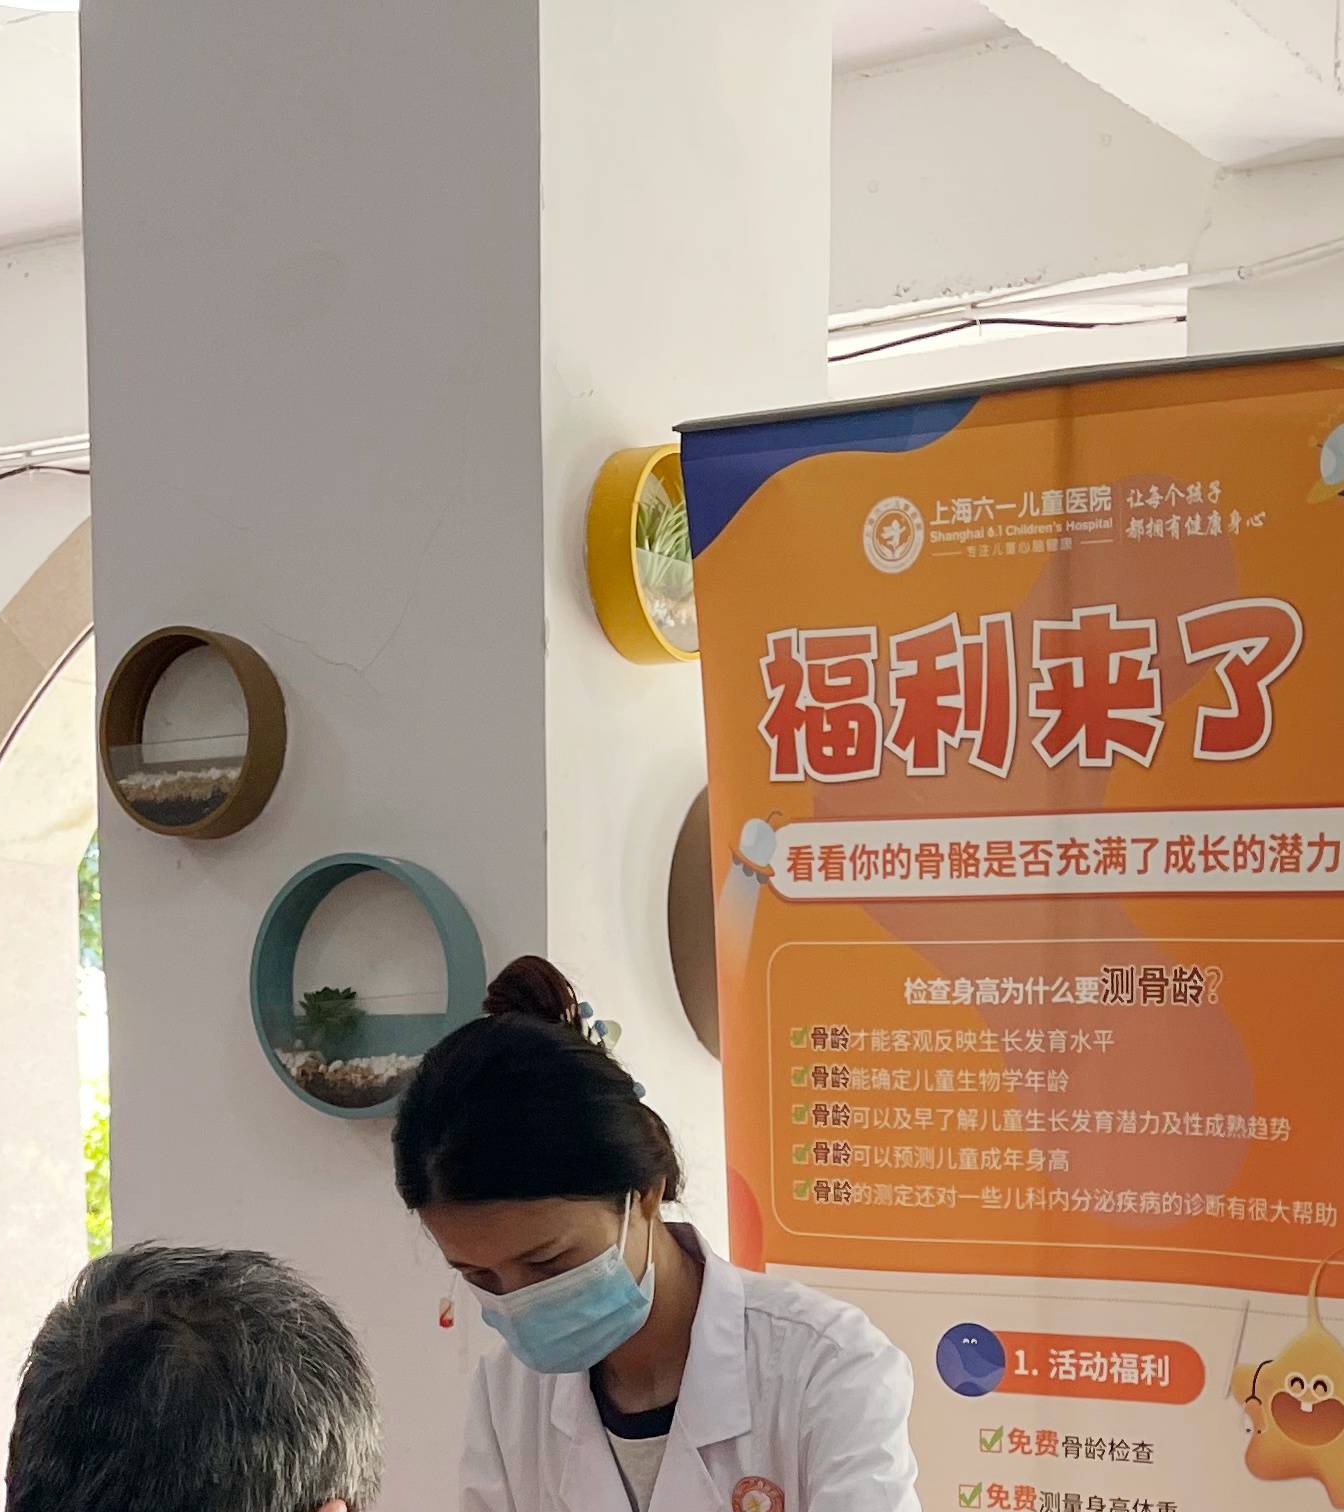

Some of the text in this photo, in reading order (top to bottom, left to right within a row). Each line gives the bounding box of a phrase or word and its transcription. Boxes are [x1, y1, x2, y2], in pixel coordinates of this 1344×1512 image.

[929, 486, 1113, 527] 上海六一儿童医院
[929, 526, 986, 544] Shanghai
[1006, 520, 1062, 537] Children's
[1065, 516, 1114, 534] Hospital
[810, 1024, 1115, 1053] 骨龄才能客观反映生长发育水平
[810, 1064, 1070, 1093] 骨龄能确定儿童生物学年龄
[811, 1102, 1291, 1142] 骨龄可以及早了解儿童生长发育潜力及性成熟趋势
[812, 1140, 1070, 1173] 骨龄可以预测儿童成年身高
[1048, 1348, 1171, 1388] 活动福利
[1007, 1427, 1155, 1465] 免费骨龄检查
